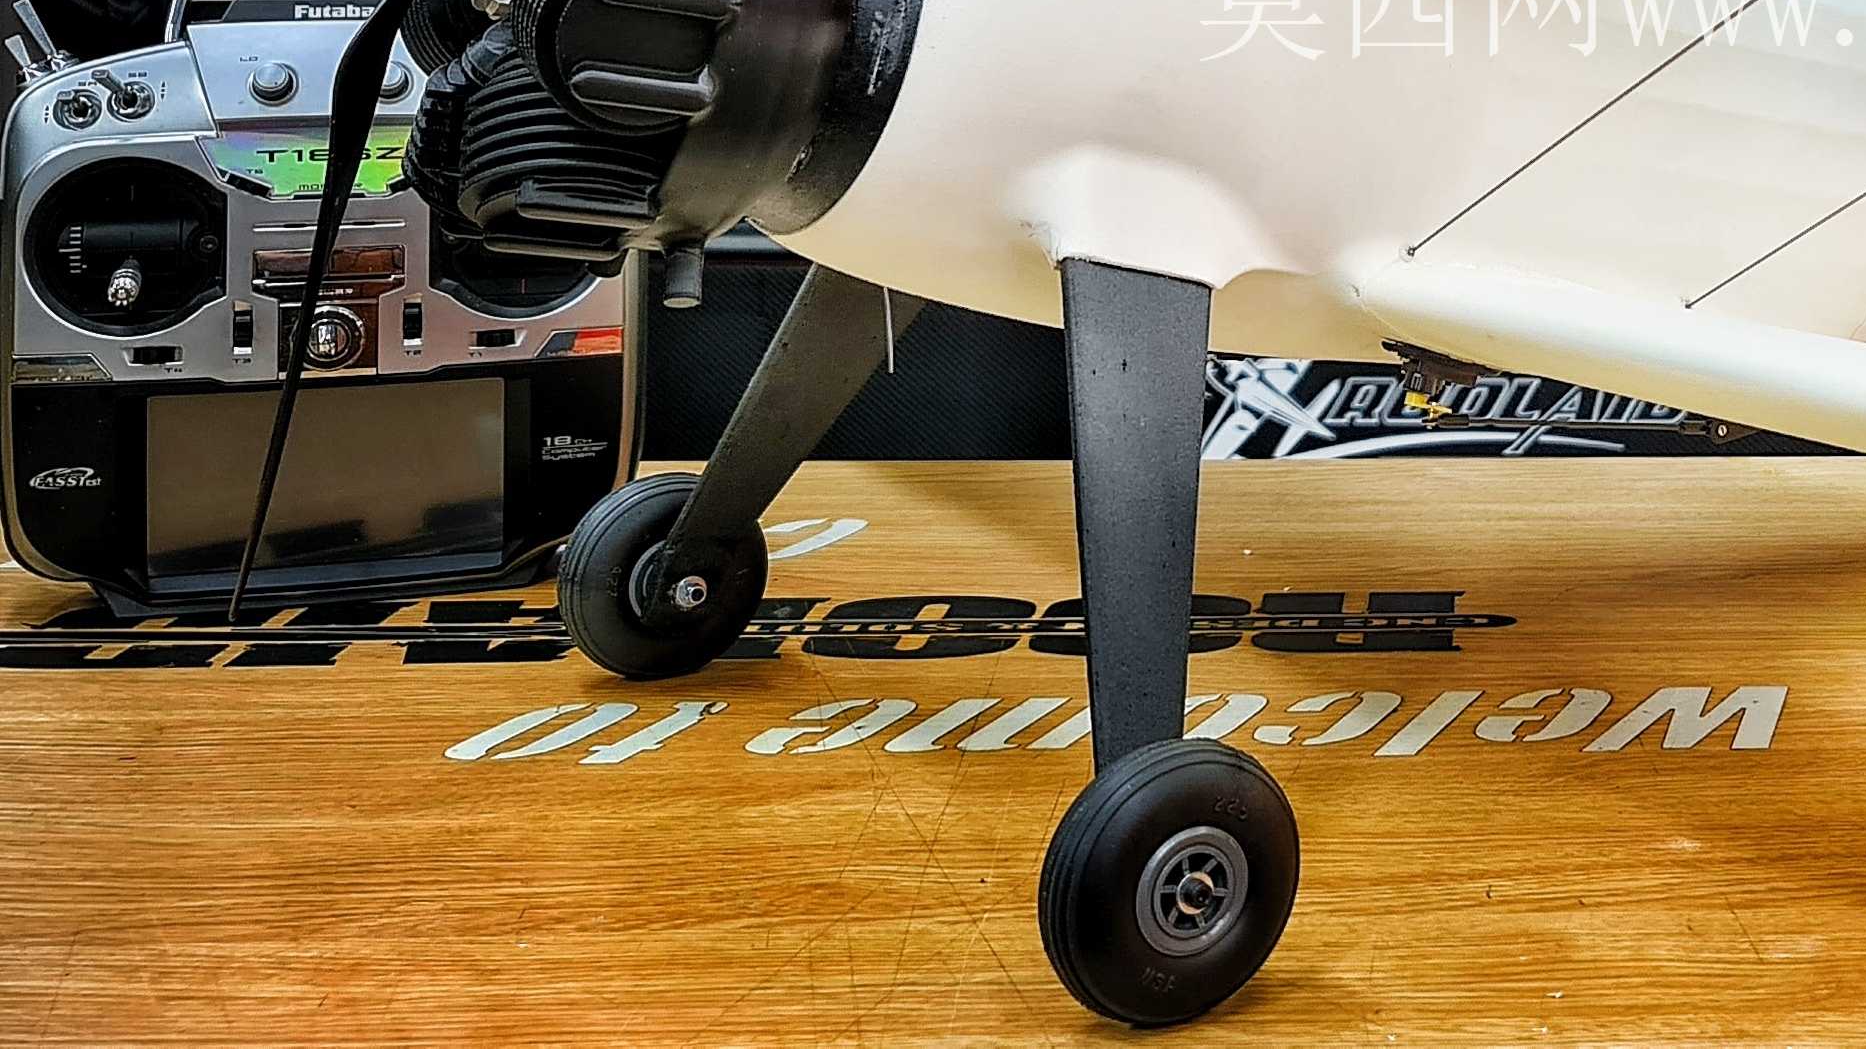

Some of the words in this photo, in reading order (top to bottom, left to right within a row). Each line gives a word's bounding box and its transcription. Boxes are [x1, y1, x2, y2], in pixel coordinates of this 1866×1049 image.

[294, 3, 377, 19] Futaba
[543, 435, 571, 447] 18
[1342, 615, 1489, 628] CNC
[743, 686, 1788, 756] Welcome
[443, 701, 729, 765] to
